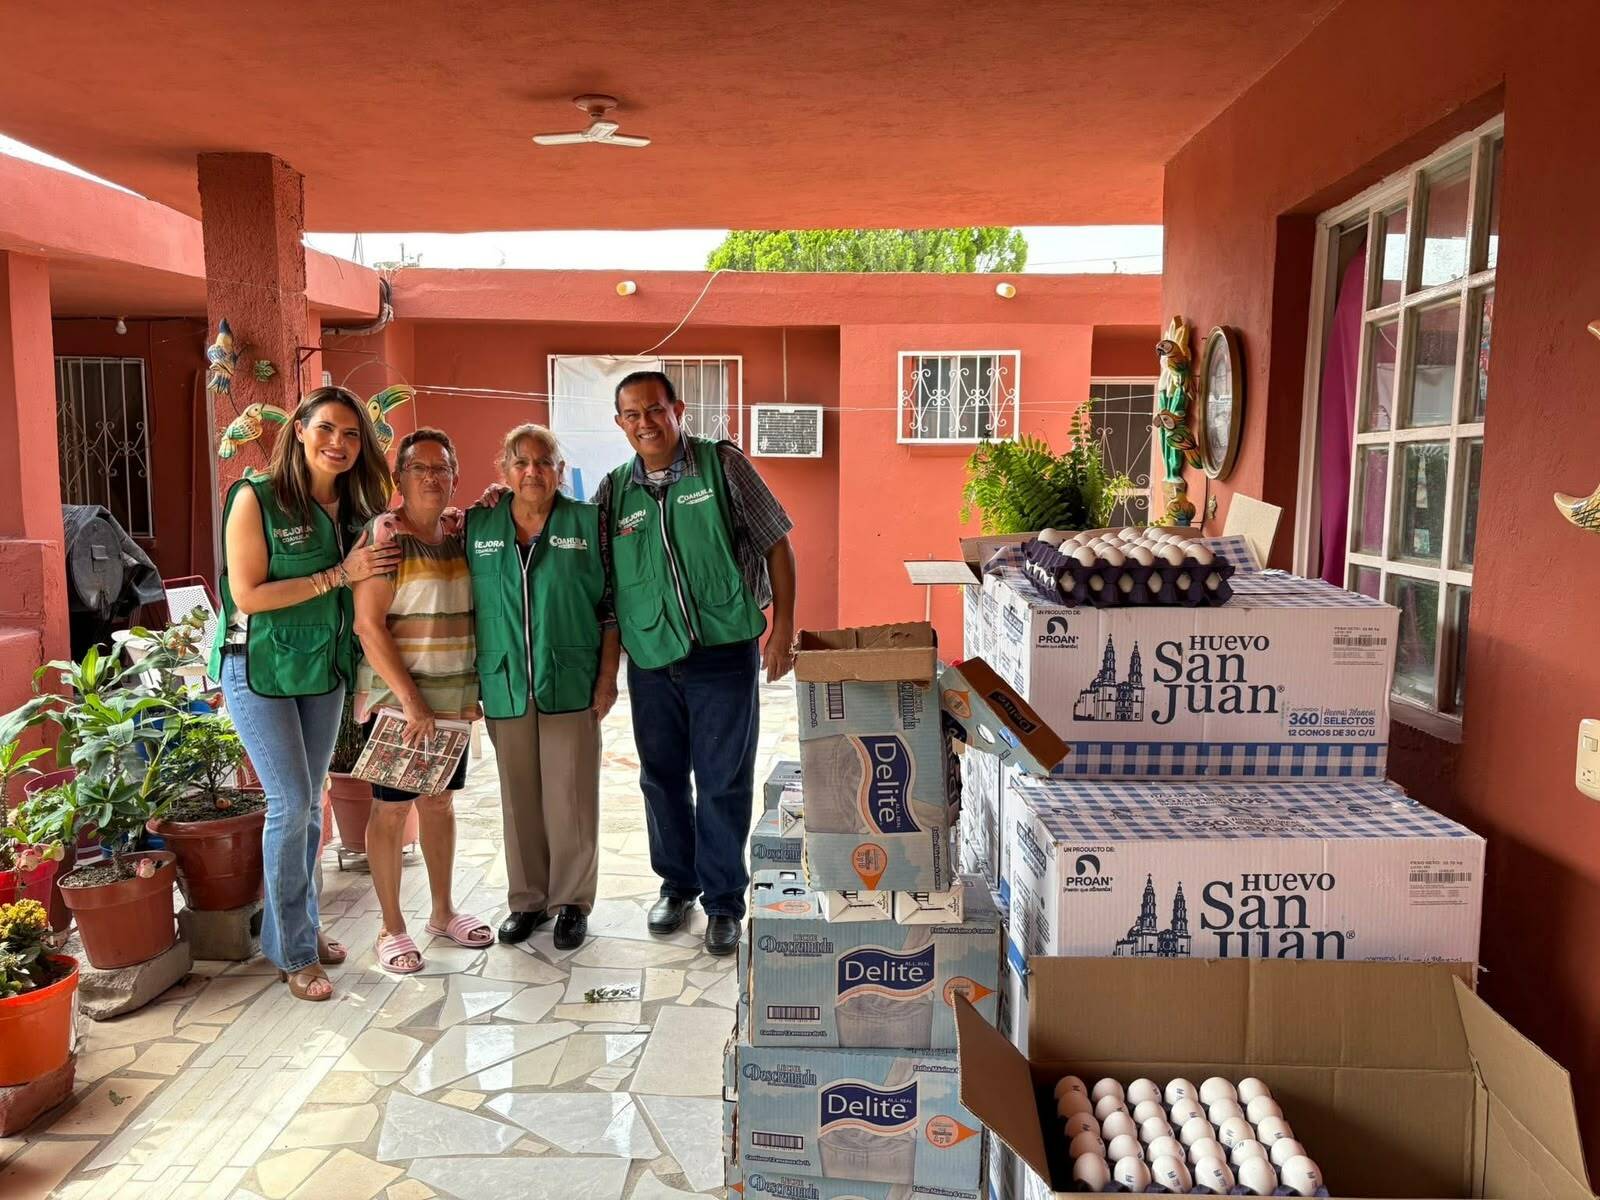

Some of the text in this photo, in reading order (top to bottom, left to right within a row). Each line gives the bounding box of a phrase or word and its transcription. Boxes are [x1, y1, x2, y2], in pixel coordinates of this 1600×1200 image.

[1153, 641, 1247, 683] San
[1289, 712, 1319, 725] 360
[1323, 717, 1375, 725] SELECTOS
[874, 743, 899, 823] Delite
[1200, 880, 1311, 930] San
[845, 961, 924, 982] Delite
[828, 1094, 906, 1119] Delite
